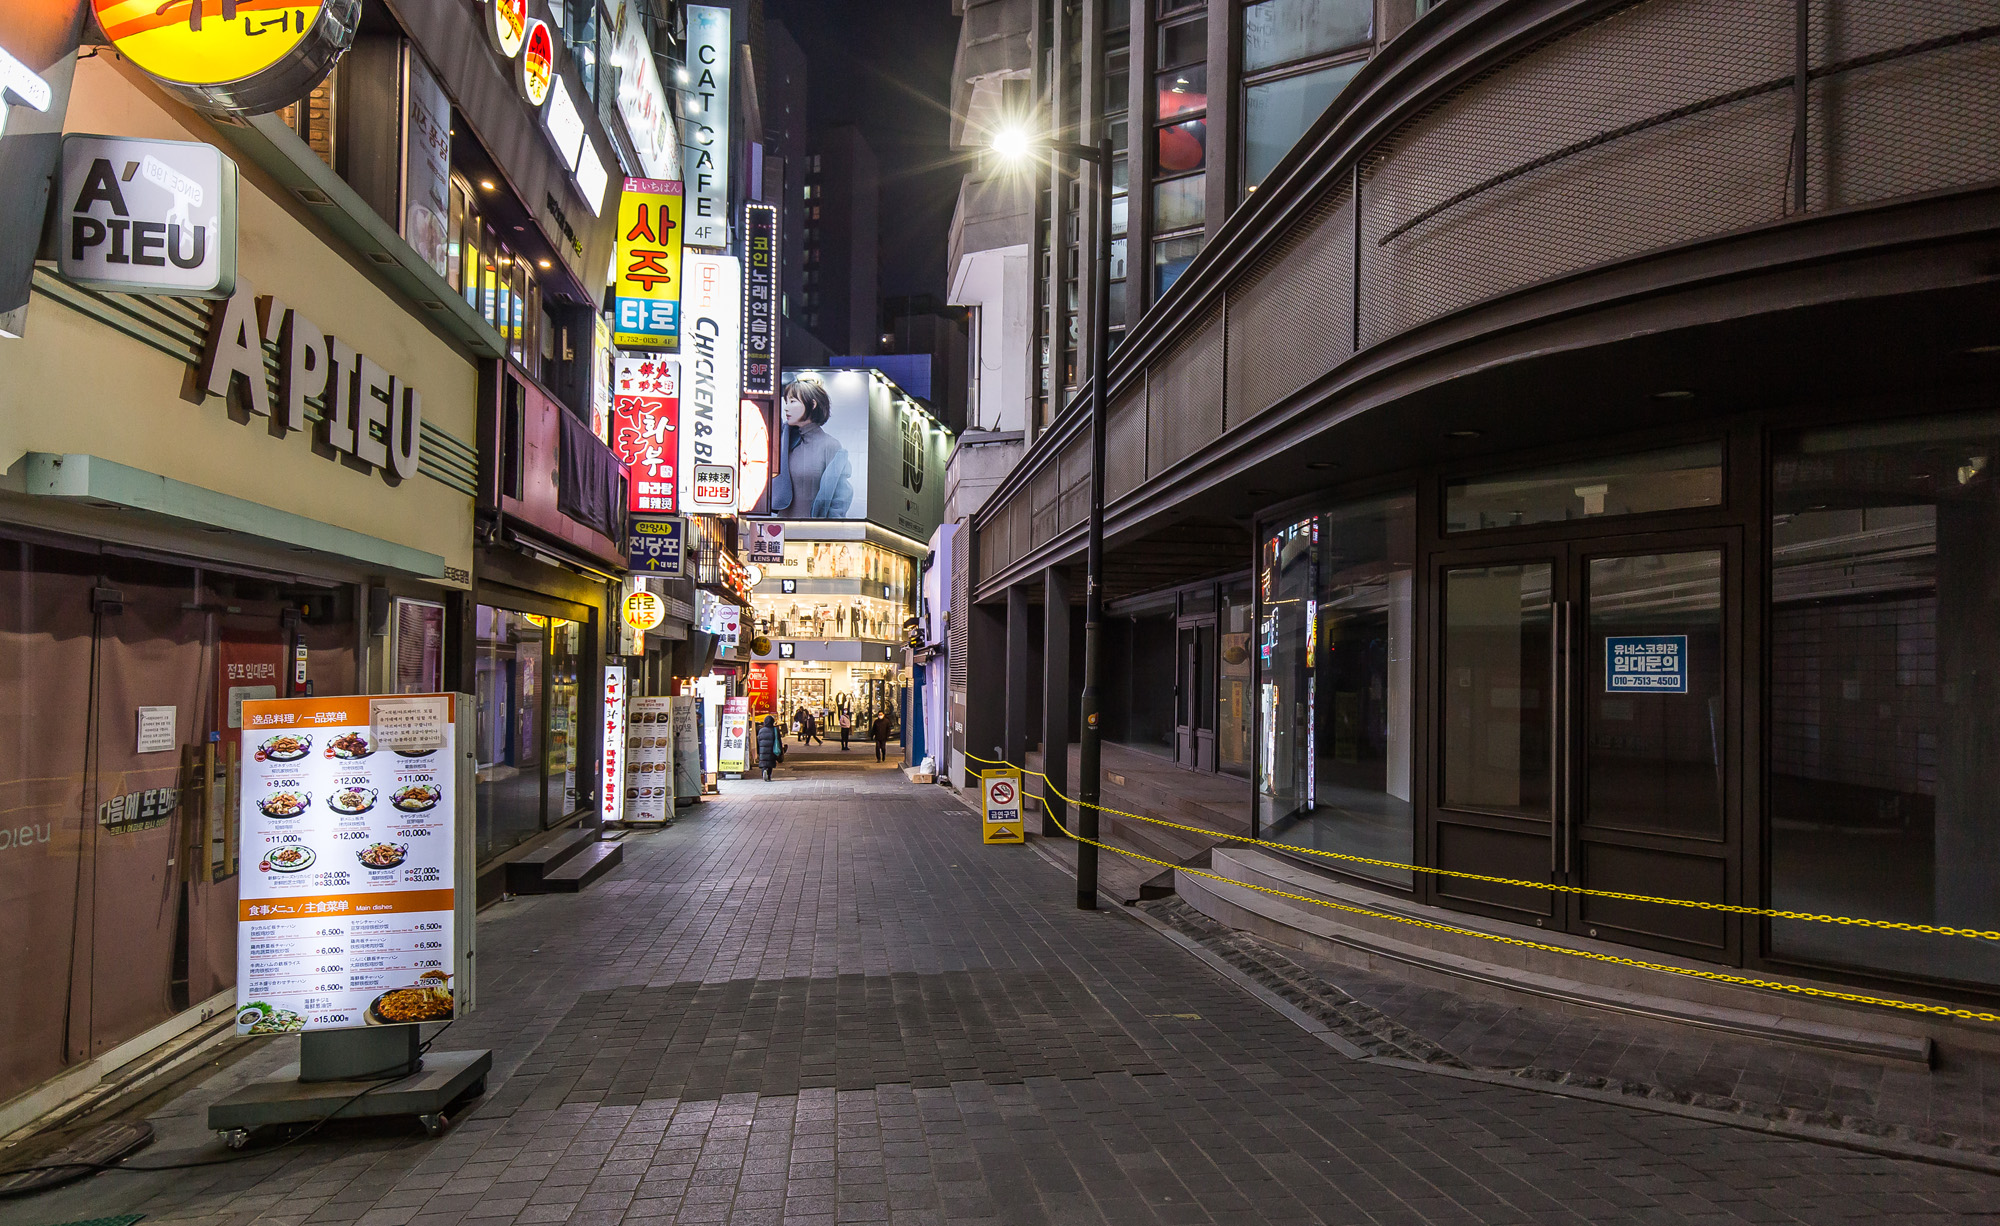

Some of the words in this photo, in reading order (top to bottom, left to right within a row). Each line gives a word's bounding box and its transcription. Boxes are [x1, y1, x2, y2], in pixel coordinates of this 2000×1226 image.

[698, 45, 716, 112] CAT
[696, 126, 715, 217] CAFE
[625, 178, 638, 192] 占
[642, 182, 681, 193] いちばん
[695, 226, 712, 239] 4F
[72, 216, 206, 269] PIEU
[626, 203, 676, 292] 사주
[621, 300, 675, 330] 타로
[751, 364, 768, 375] 3F
[638, 481, 674, 495] 마라탕
[697, 486, 731, 498] 마라탕
[639, 523, 668, 533] 한양사
[757, 524, 764, 538] I
[630, 538, 679, 557] 전당포
[660, 561, 678, 569] 대부업
[781, 558, 798, 566] IDS
[629, 598, 655, 610] 타로
[629, 612, 655, 625] 사주
[720, 622, 725, 631] I
[1614, 644, 1678, 655] 유네스코회관
[1614, 656, 1679, 672] 임대문의
[227, 664, 245, 679] 점포
[246, 663, 276, 678] 임대문의
[1614, 677, 1679, 686] 010-7513-4500
[252, 713, 294, 725] 逸品料理
[98, 792, 140, 824] 다음에
[142, 788, 157, 818] 또
[991, 810, 1016, 819] 금연구역
